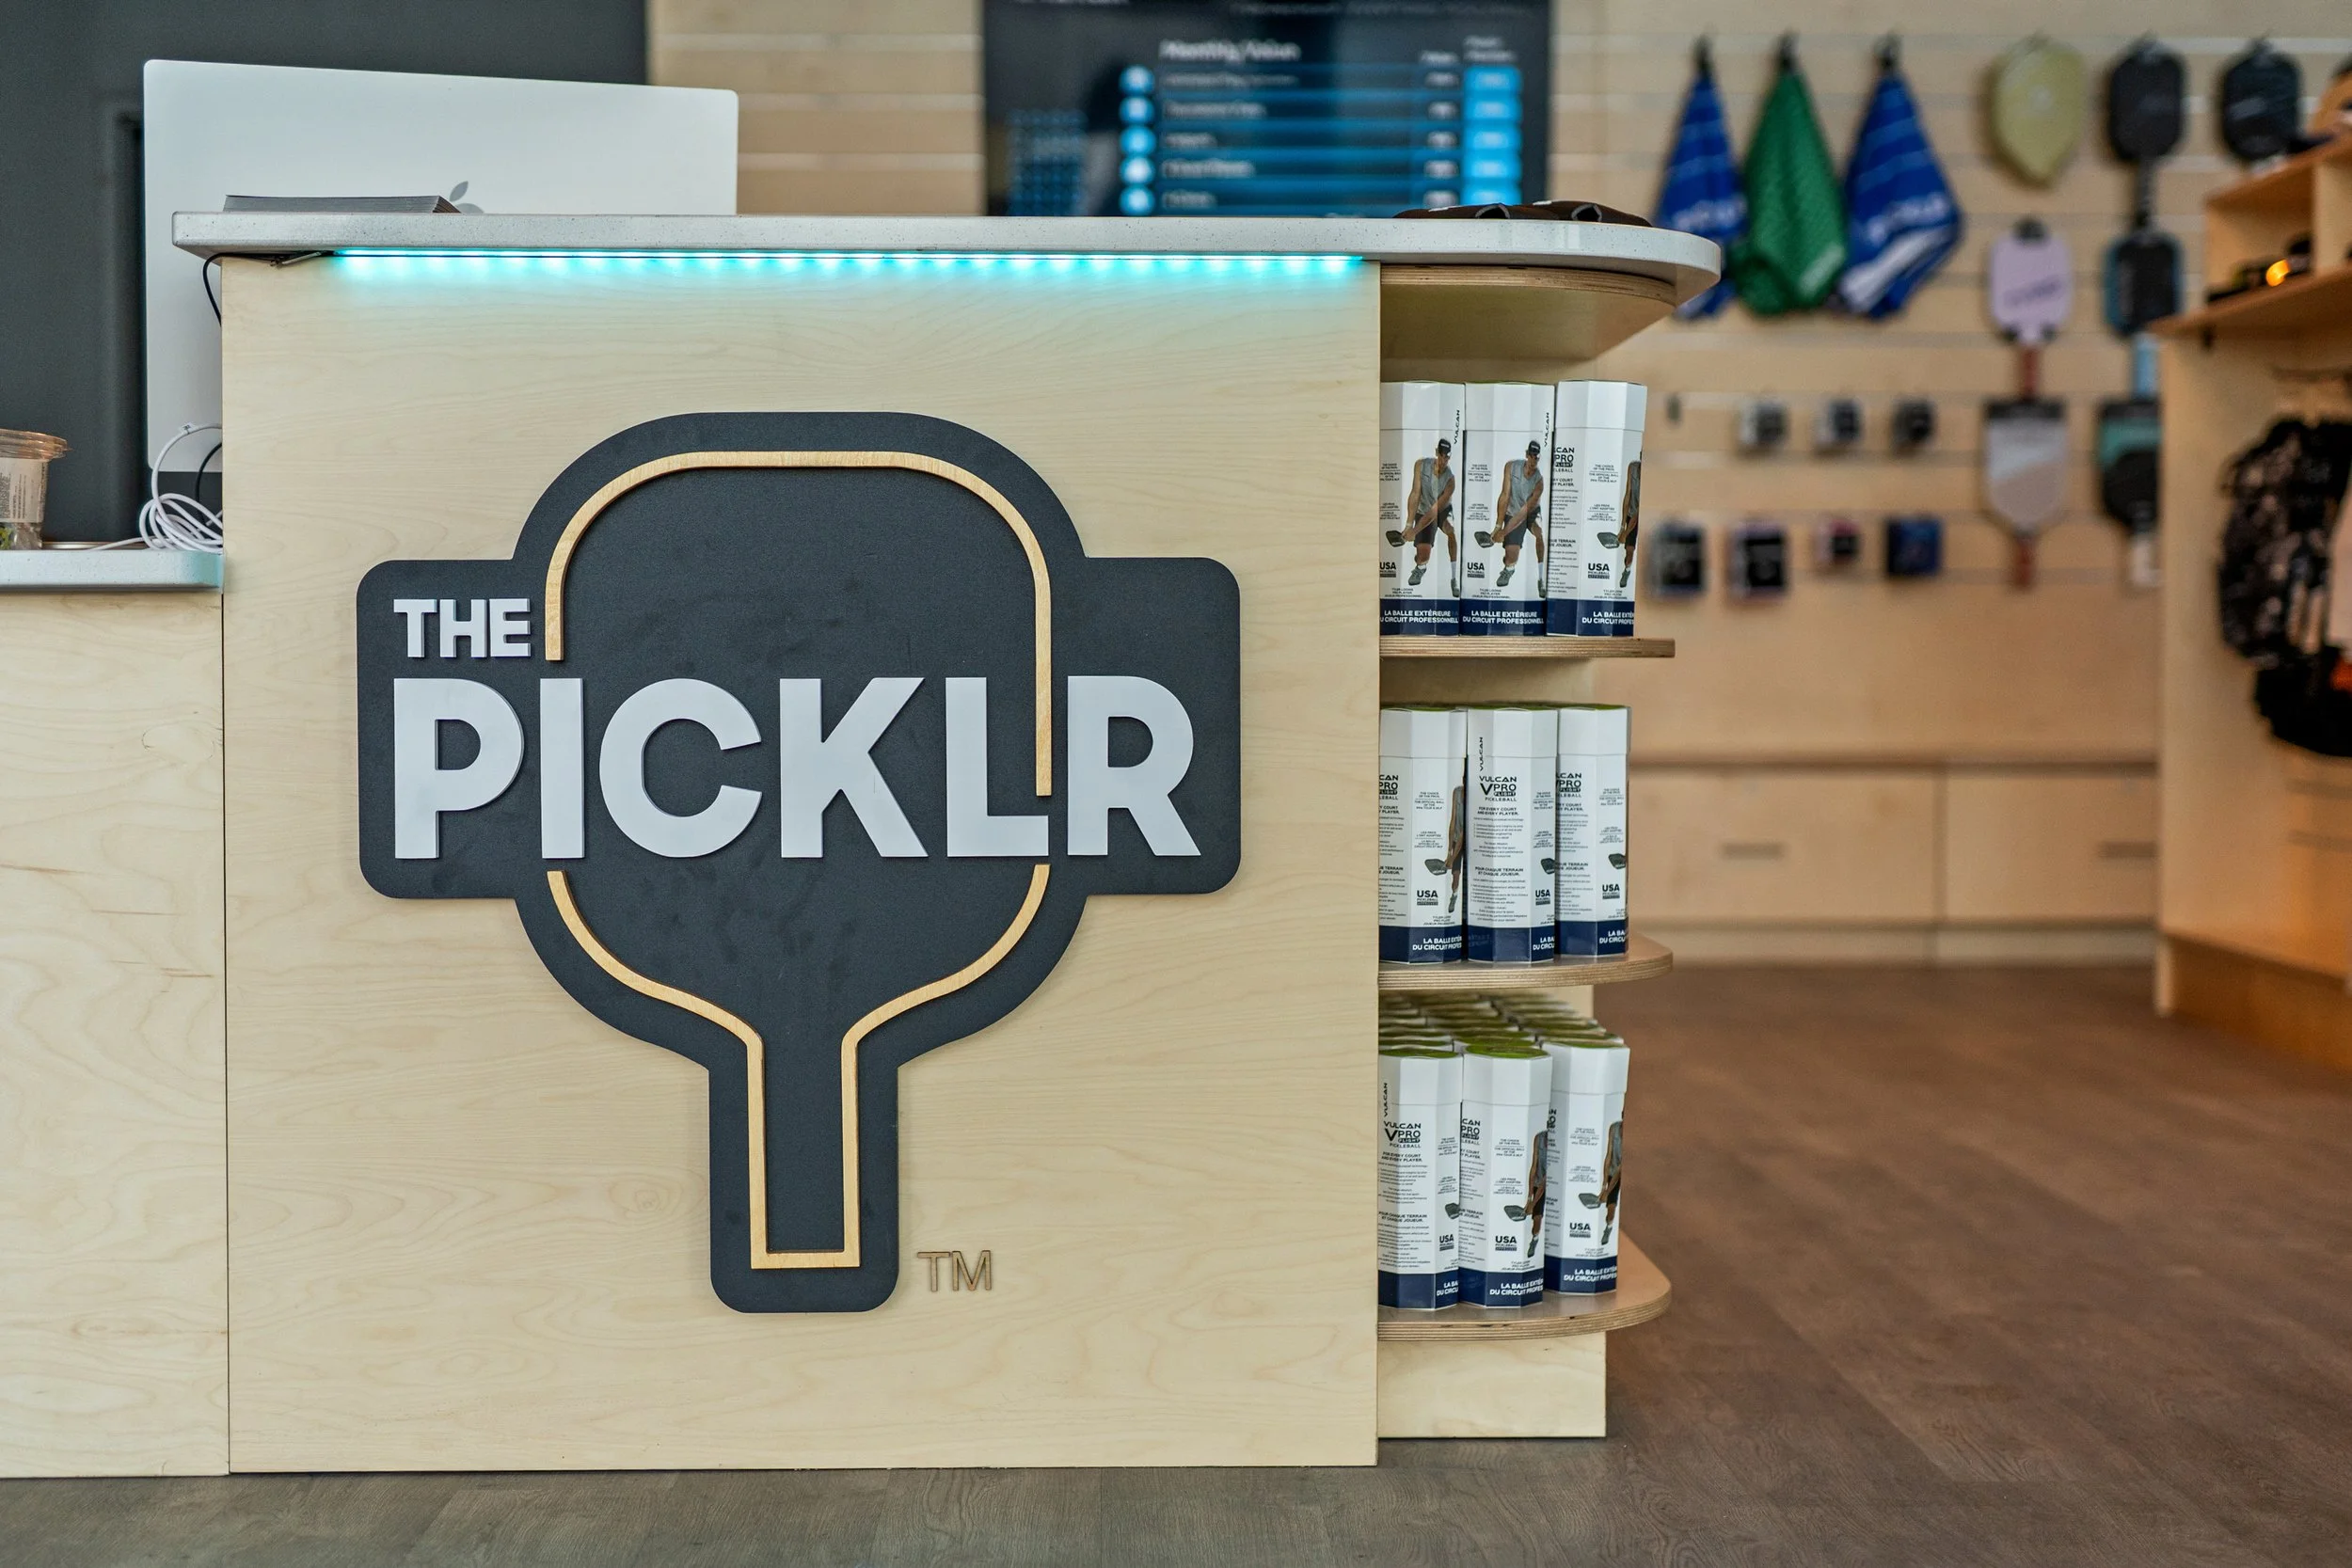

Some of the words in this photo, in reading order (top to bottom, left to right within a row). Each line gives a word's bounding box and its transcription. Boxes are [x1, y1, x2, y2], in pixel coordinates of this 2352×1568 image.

[1553, 454, 1574, 463] PRO
[1379, 562, 1397, 570] USA
[1467, 562, 1485, 571] USA
[1587, 562, 1610, 572] USA
[393, 598, 532, 658] THE
[392, 674, 1201, 860] PICKLR
[1379, 782, 1399, 790] PRO
[1602, 883, 1620, 892] USA
[1416, 890, 1438, 898] USA
[1535, 889, 1550, 897] USA
[1383, 1120, 1422, 1130] VULCAN
[1461, 1125, 1480, 1135] PRO
[1569, 1222, 1591, 1230] USA
[1439, 1234, 1454, 1243] USA
[1495, 1235, 1517, 1243] USA
[917, 1249, 992, 1292] TM
[1511, 1281, 1530, 1290] BALLE
